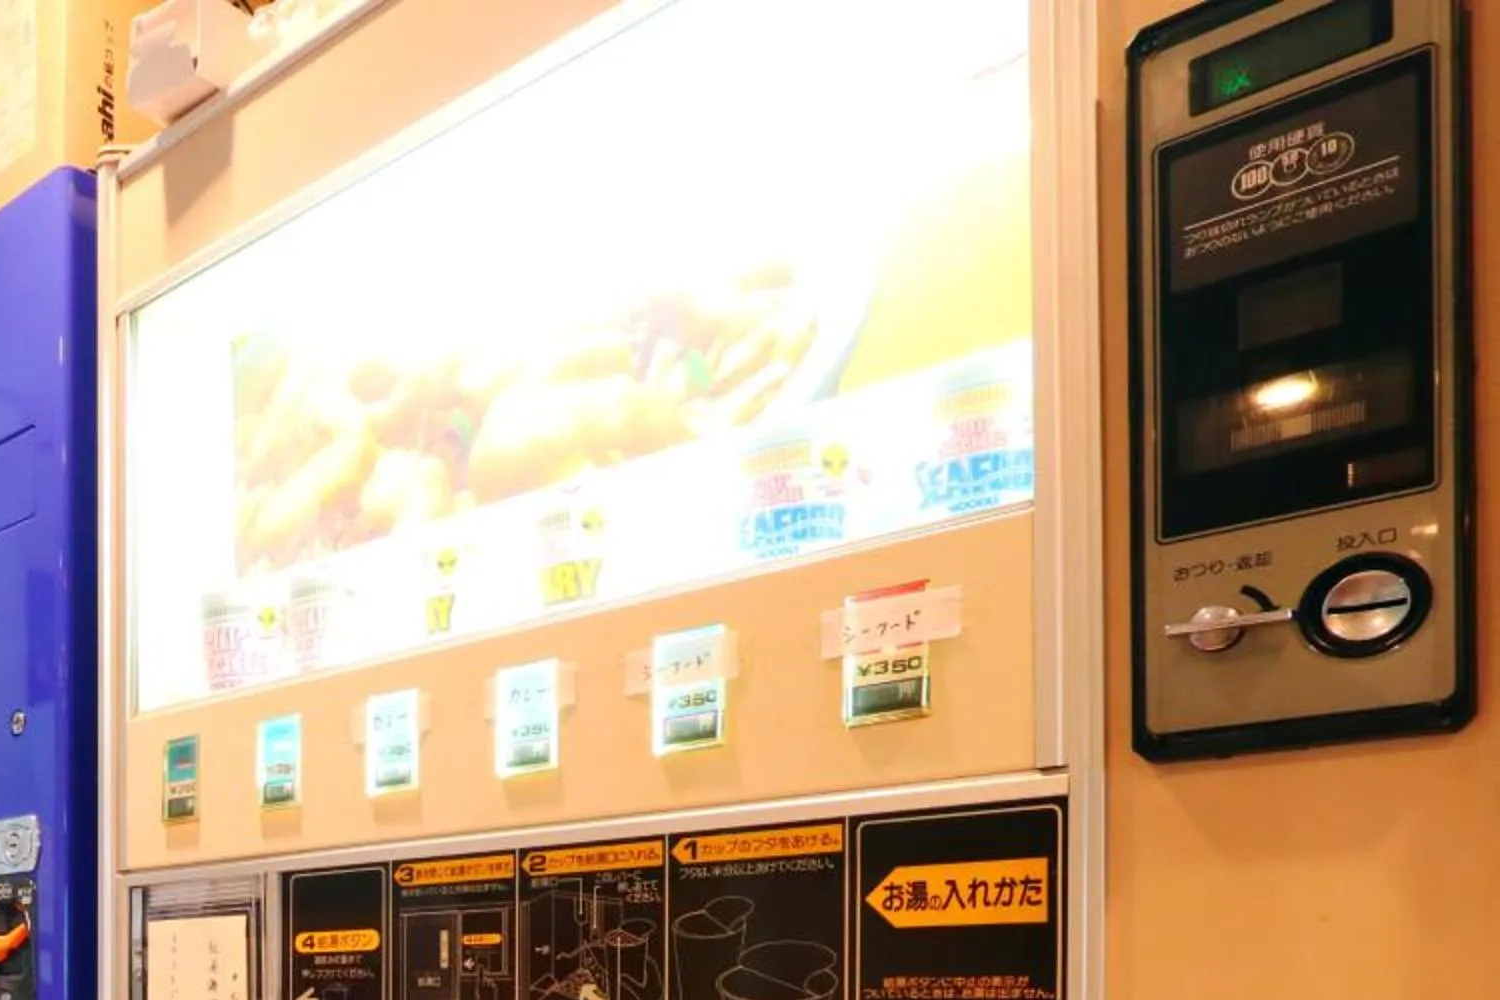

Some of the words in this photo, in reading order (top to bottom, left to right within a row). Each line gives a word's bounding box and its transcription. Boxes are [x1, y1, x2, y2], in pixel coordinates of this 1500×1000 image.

[1240, 167, 1268, 190] 100
[1320, 140, 1338, 156] 10
[1337, 527, 1398, 551] 投入口
[1173, 551, 1274, 582] おつり・返却
[841, 610, 923, 644] シーフード
[643, 651, 712, 680] シーフード
[856, 655, 923, 678] ¥350
[683, 841, 699, 862] 1
[399, 863, 415, 882] 3
[529, 855, 547, 873] 2
[881, 876, 1045, 913] お湯の入れかた
[301, 935, 316, 951] 4
